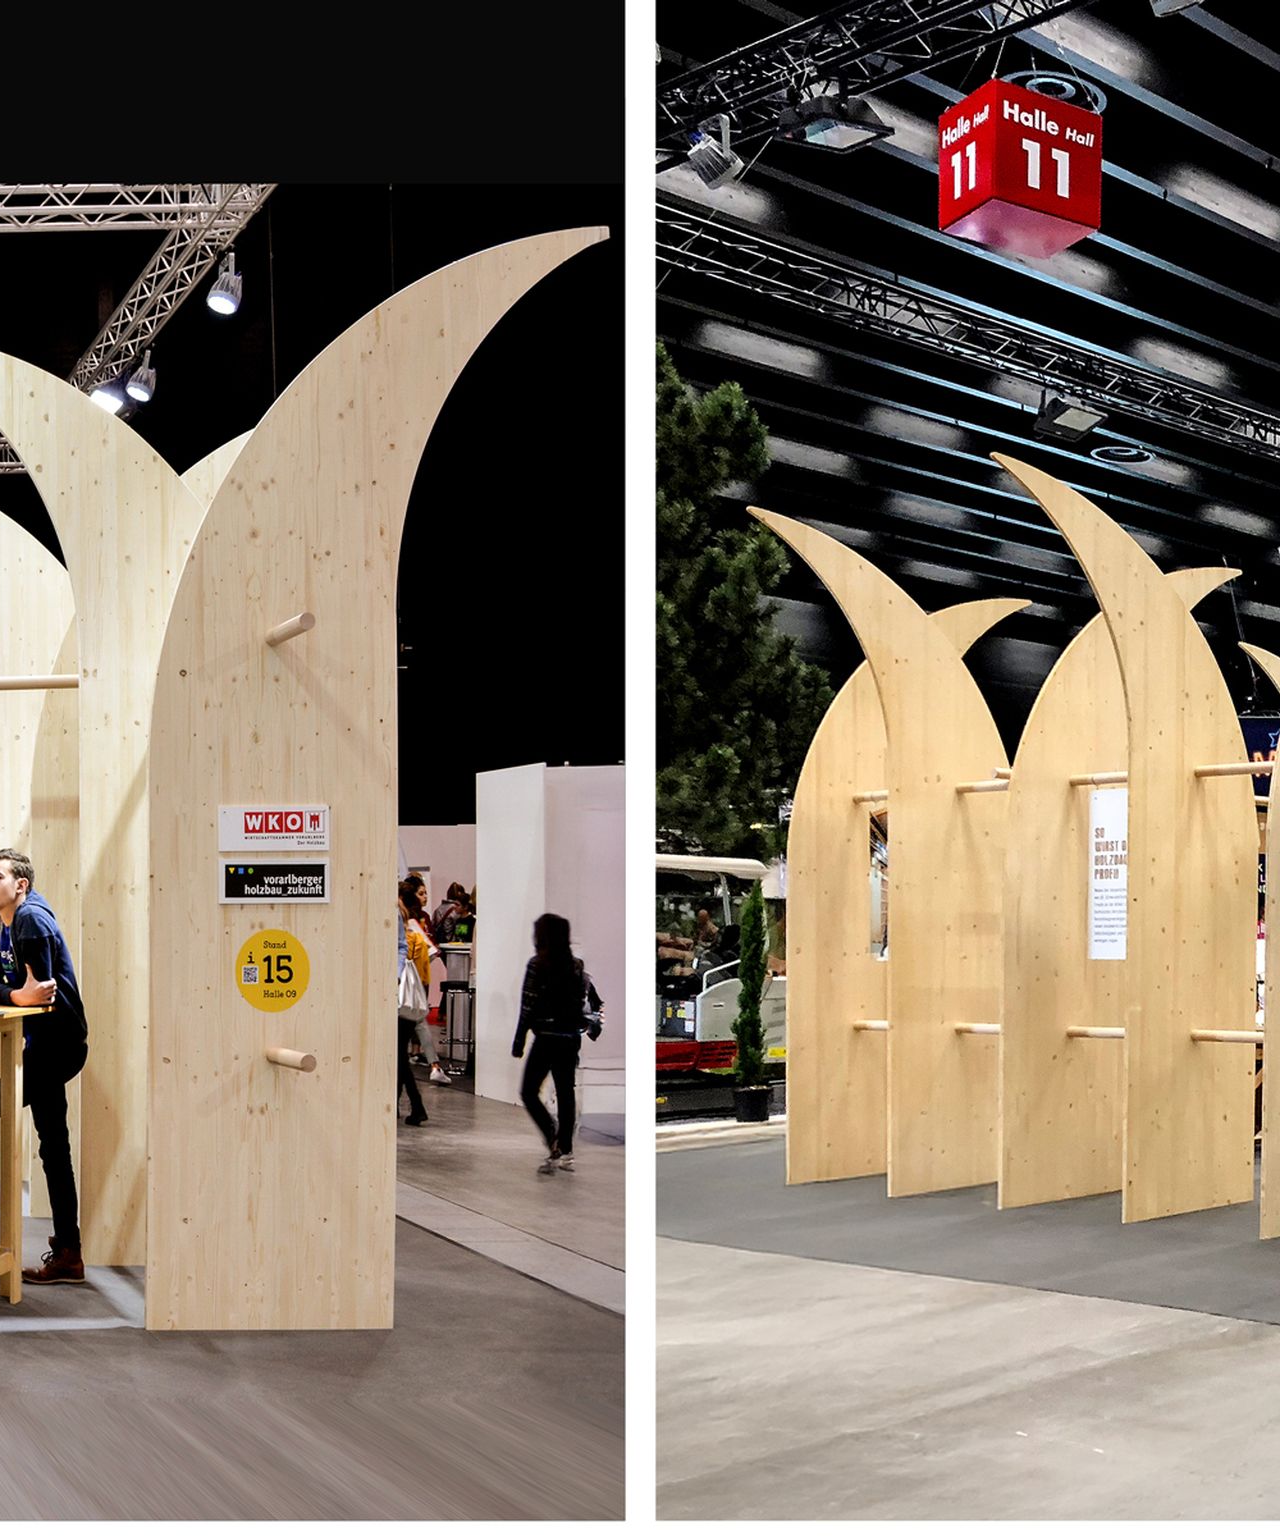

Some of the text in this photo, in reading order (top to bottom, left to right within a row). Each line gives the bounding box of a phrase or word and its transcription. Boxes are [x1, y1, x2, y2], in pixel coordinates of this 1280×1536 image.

[942, 104, 989, 149] Halle Hall
[1003, 100, 1094, 147] Halle Hall
[951, 141, 976, 200] 11
[1022, 138, 1070, 199] 11
[244, 813, 302, 832] WKO
[1095, 827, 1105, 839] SO
[263, 874, 323, 886] vorarlberger
[244, 884, 323, 896] holzbau_zukunft
[263, 940, 287, 949] Stand
[263, 955, 294, 984] 15
[263, 990, 284, 998] Halle
